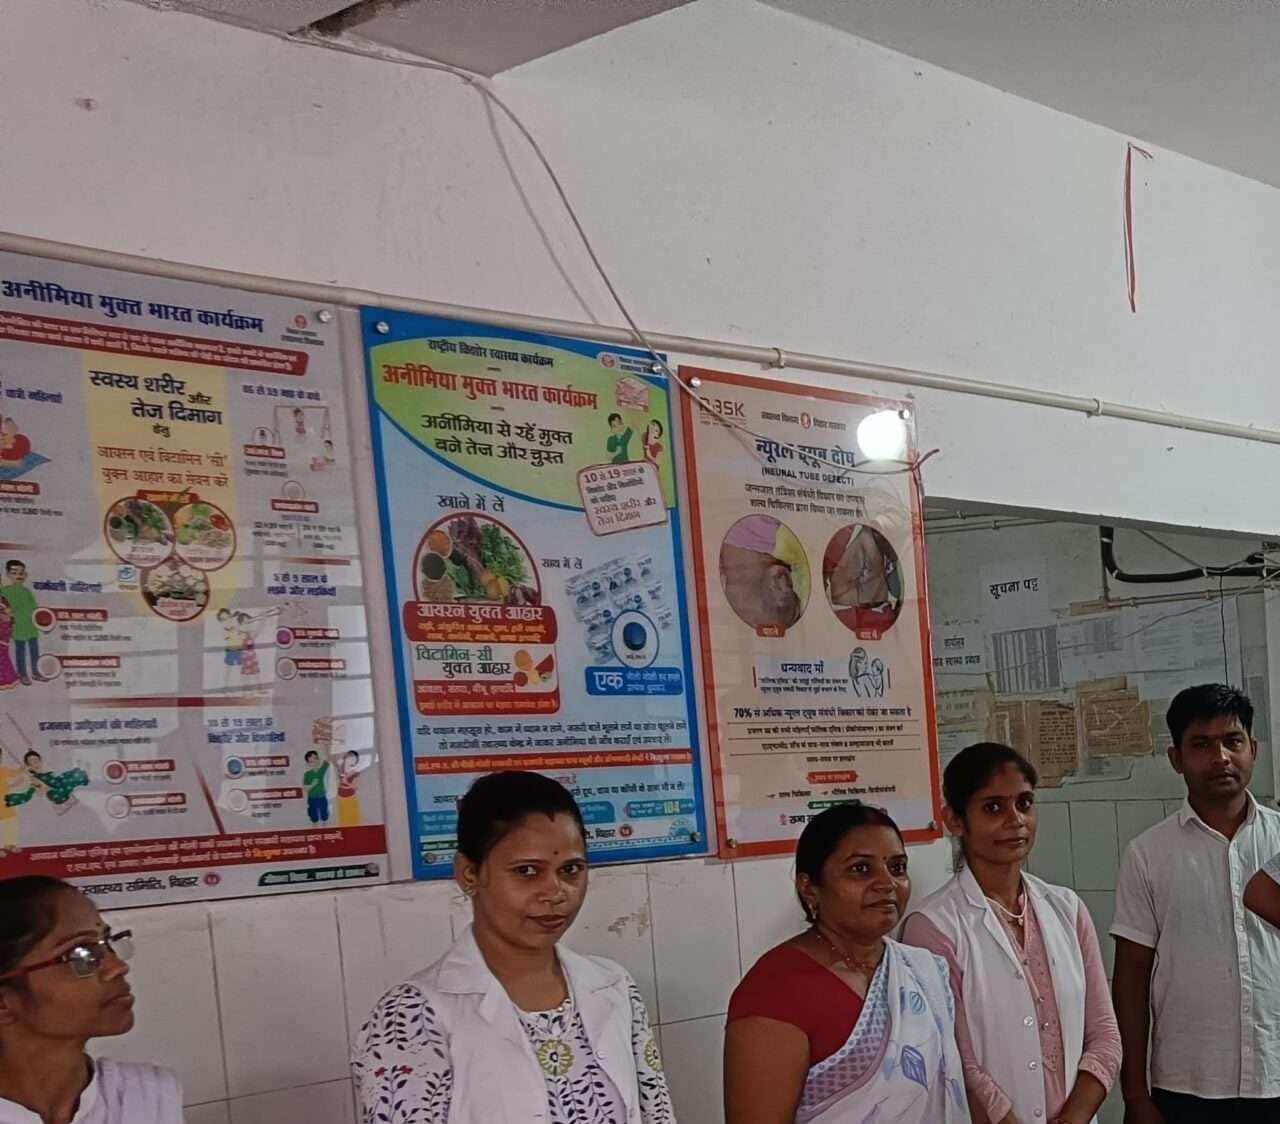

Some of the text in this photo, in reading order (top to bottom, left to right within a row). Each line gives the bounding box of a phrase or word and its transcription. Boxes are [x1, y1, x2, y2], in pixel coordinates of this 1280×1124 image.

[1, 279, 264, 333] अनीमिया मुक्त भारत कार्यक्रम
[88, 369, 186, 395] स्वस्थ शरीर
[382, 363, 598, 410] अनीमिया मुक्त भारत कार्यक्रम
[130, 397, 222, 425] तेज दिमाग
[496, 419, 511, 438] से
[514, 422, 536, 442] रहें
[538, 429, 573, 447] मुक्त
[465, 437, 493, 457] तेज
[498, 441, 527, 460] और
[530, 449, 564, 467] चुस्त
[799, 471, 820, 482] TUBE
[437, 493, 470, 511] खाने
[989, 580, 1020, 600] सूचना
[417, 603, 544, 623] आयरन युक्त आहार
[442, 662, 512, 679] युक्त आहार
[593, 671, 624, 691] एक
[733, 707, 753, 719] 70%
